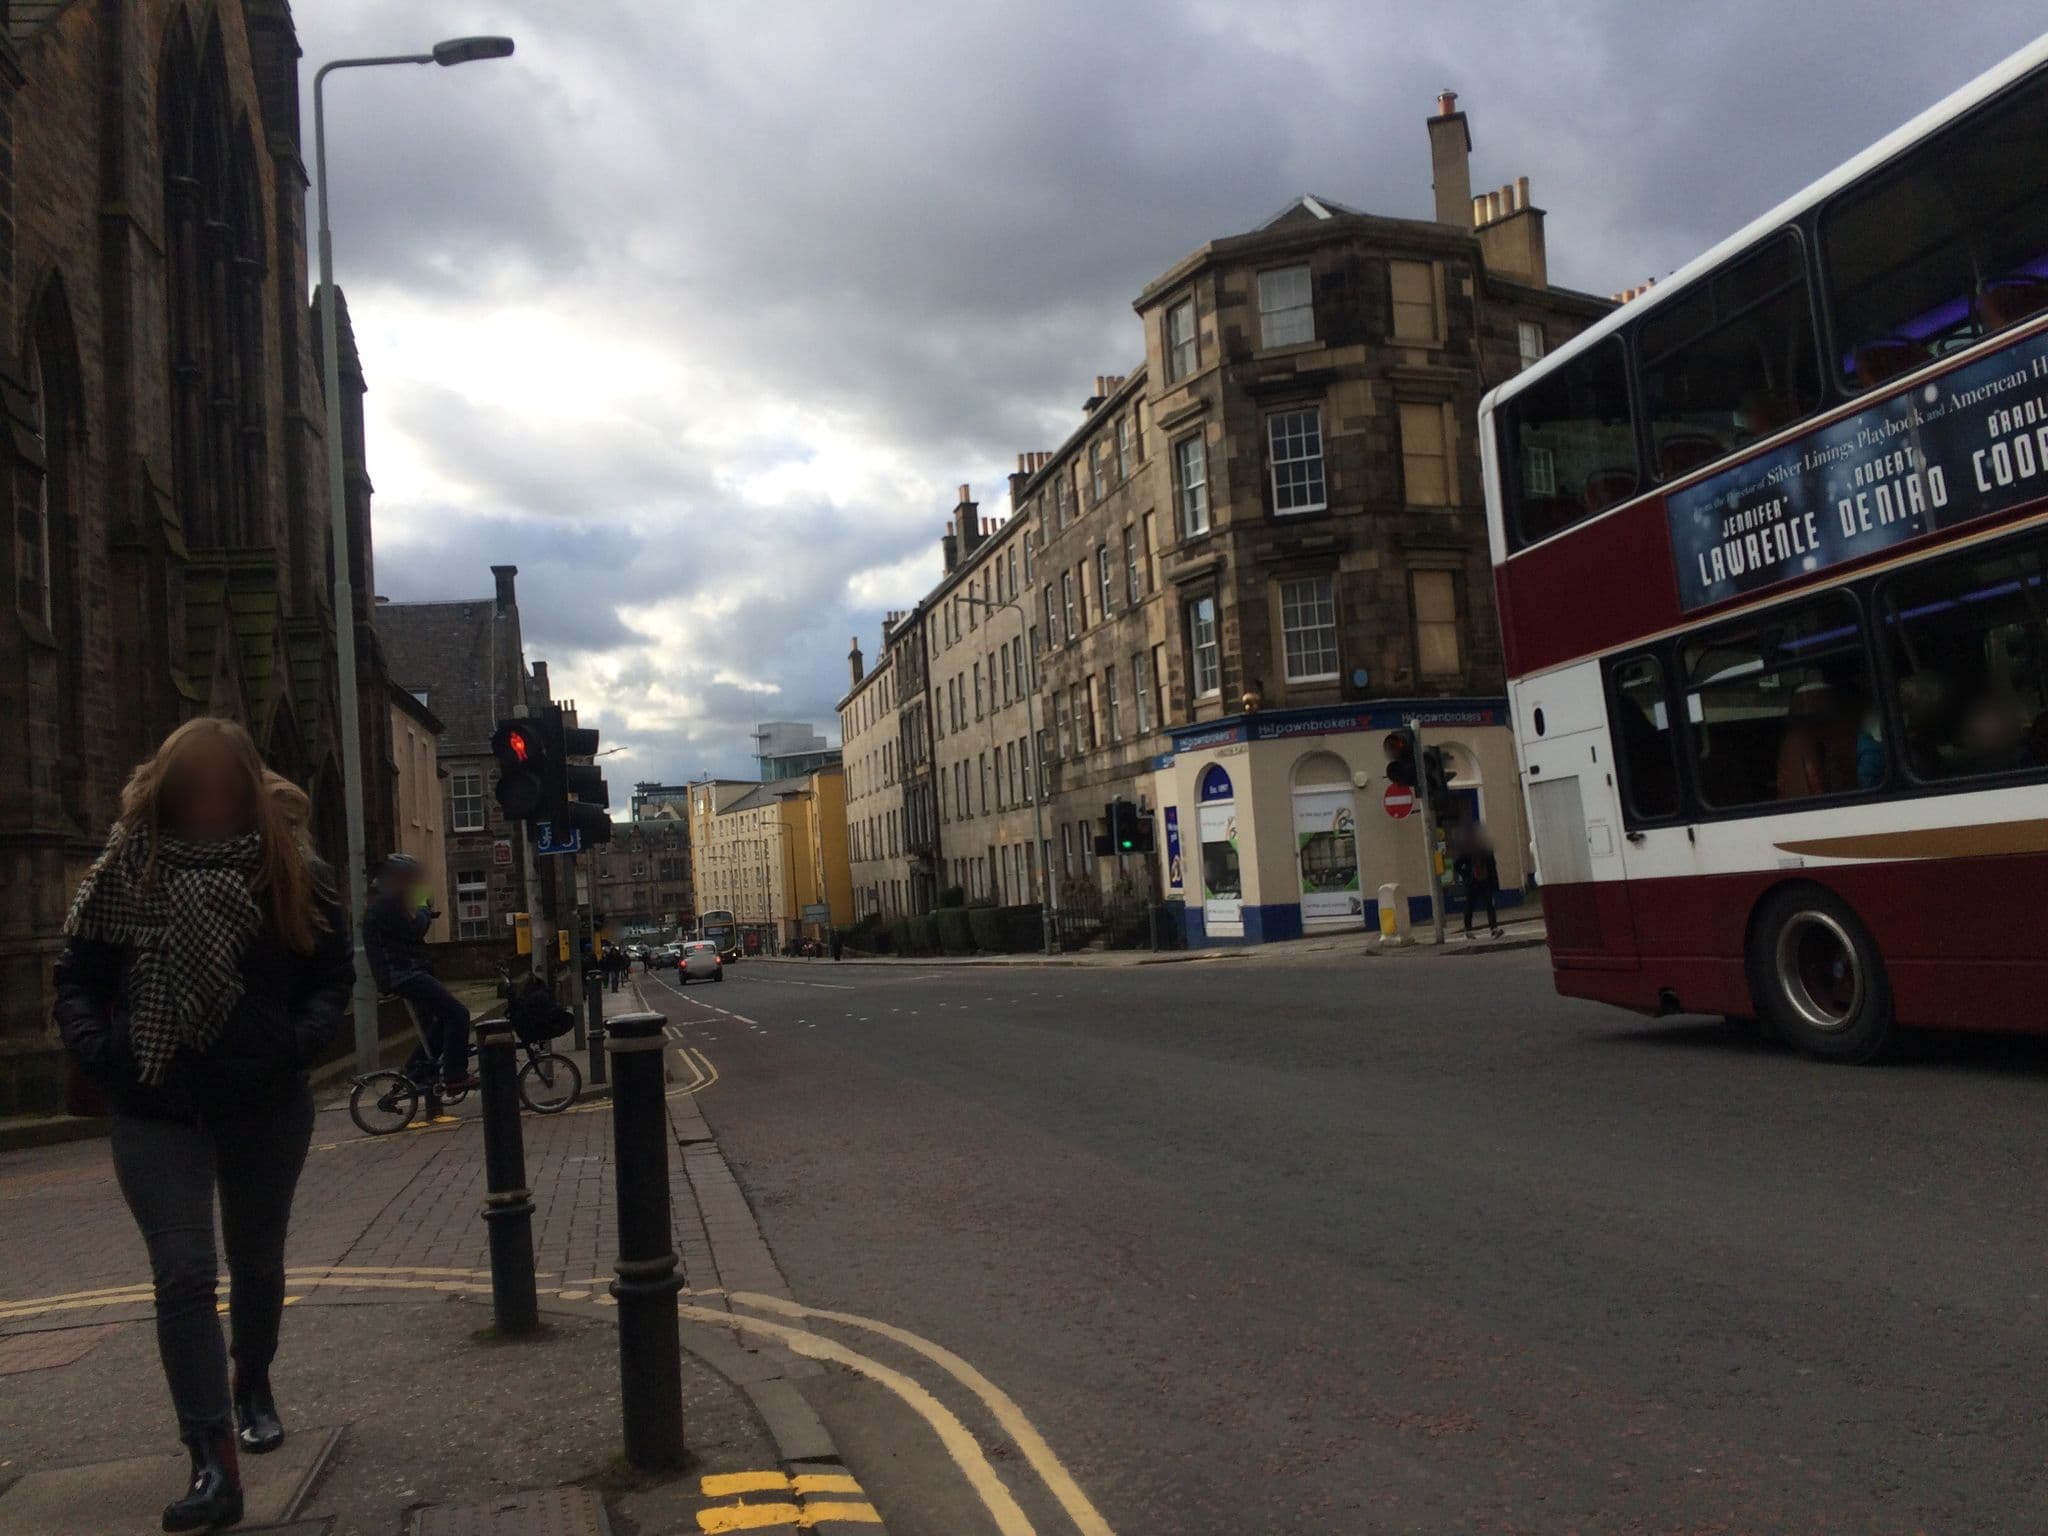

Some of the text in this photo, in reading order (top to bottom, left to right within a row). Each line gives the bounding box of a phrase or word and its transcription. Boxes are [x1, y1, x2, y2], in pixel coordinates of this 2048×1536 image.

[1767, 461, 1802, 487] Silver
[1804, 439, 1855, 471] Linings
[1857, 408, 1925, 447] Playbook
[1927, 404, 1946, 421] and
[1950, 368, 2028, 413] American
[1854, 446, 1914, 487] ROBERT
[1723, 499, 1782, 538] JENNIFER
[1698, 511, 1820, 587] LAWRENCE
